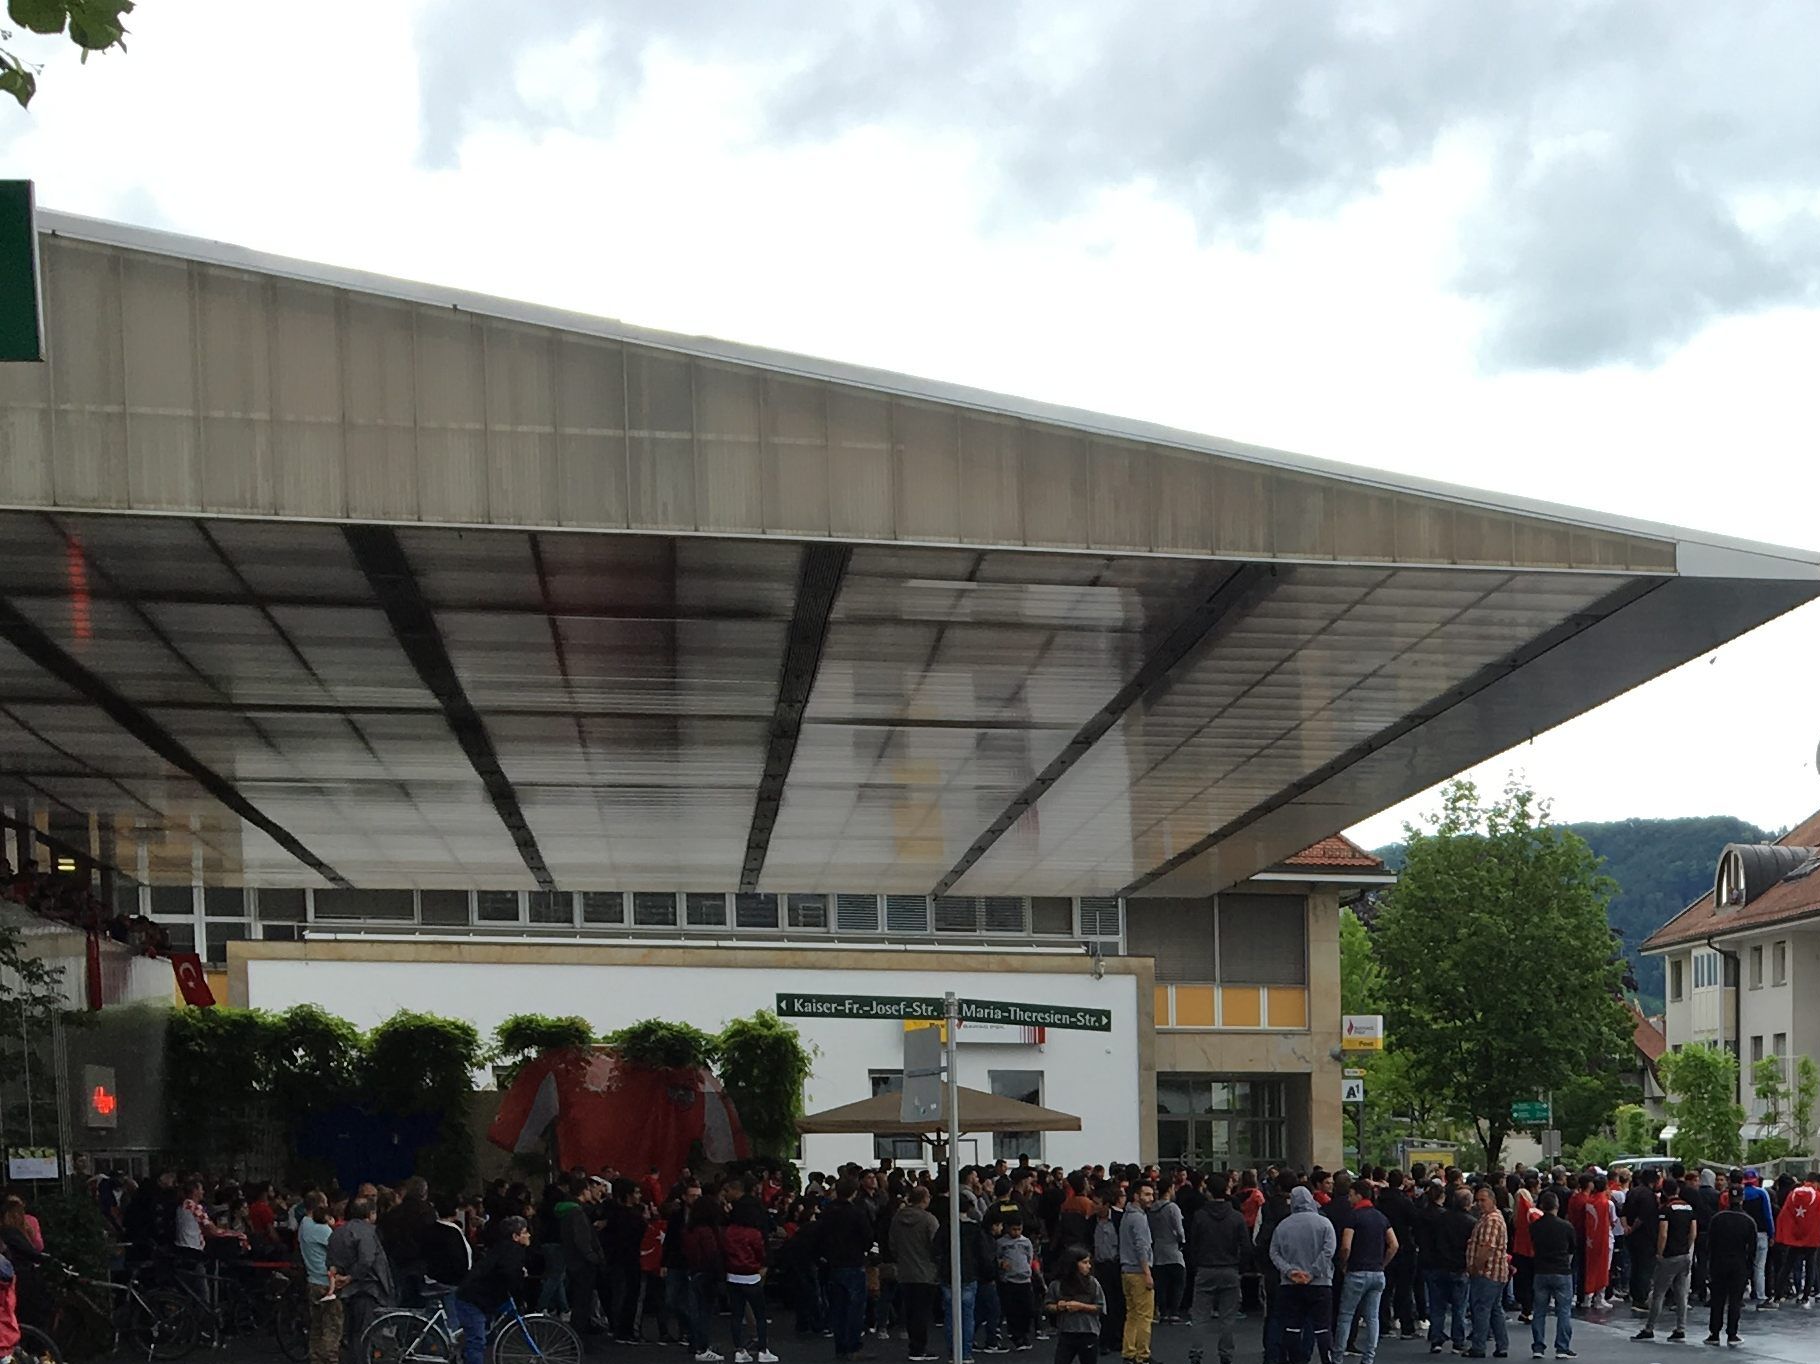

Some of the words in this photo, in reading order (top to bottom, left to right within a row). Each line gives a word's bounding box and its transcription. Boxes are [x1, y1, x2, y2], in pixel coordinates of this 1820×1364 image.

[794, 998, 938, 1016] Kaiser-Fr.-Josef-Str.
[962, 1003, 1099, 1027] Maria-Theresien-Str.
[1346, 1084, 1360, 1099] A1
